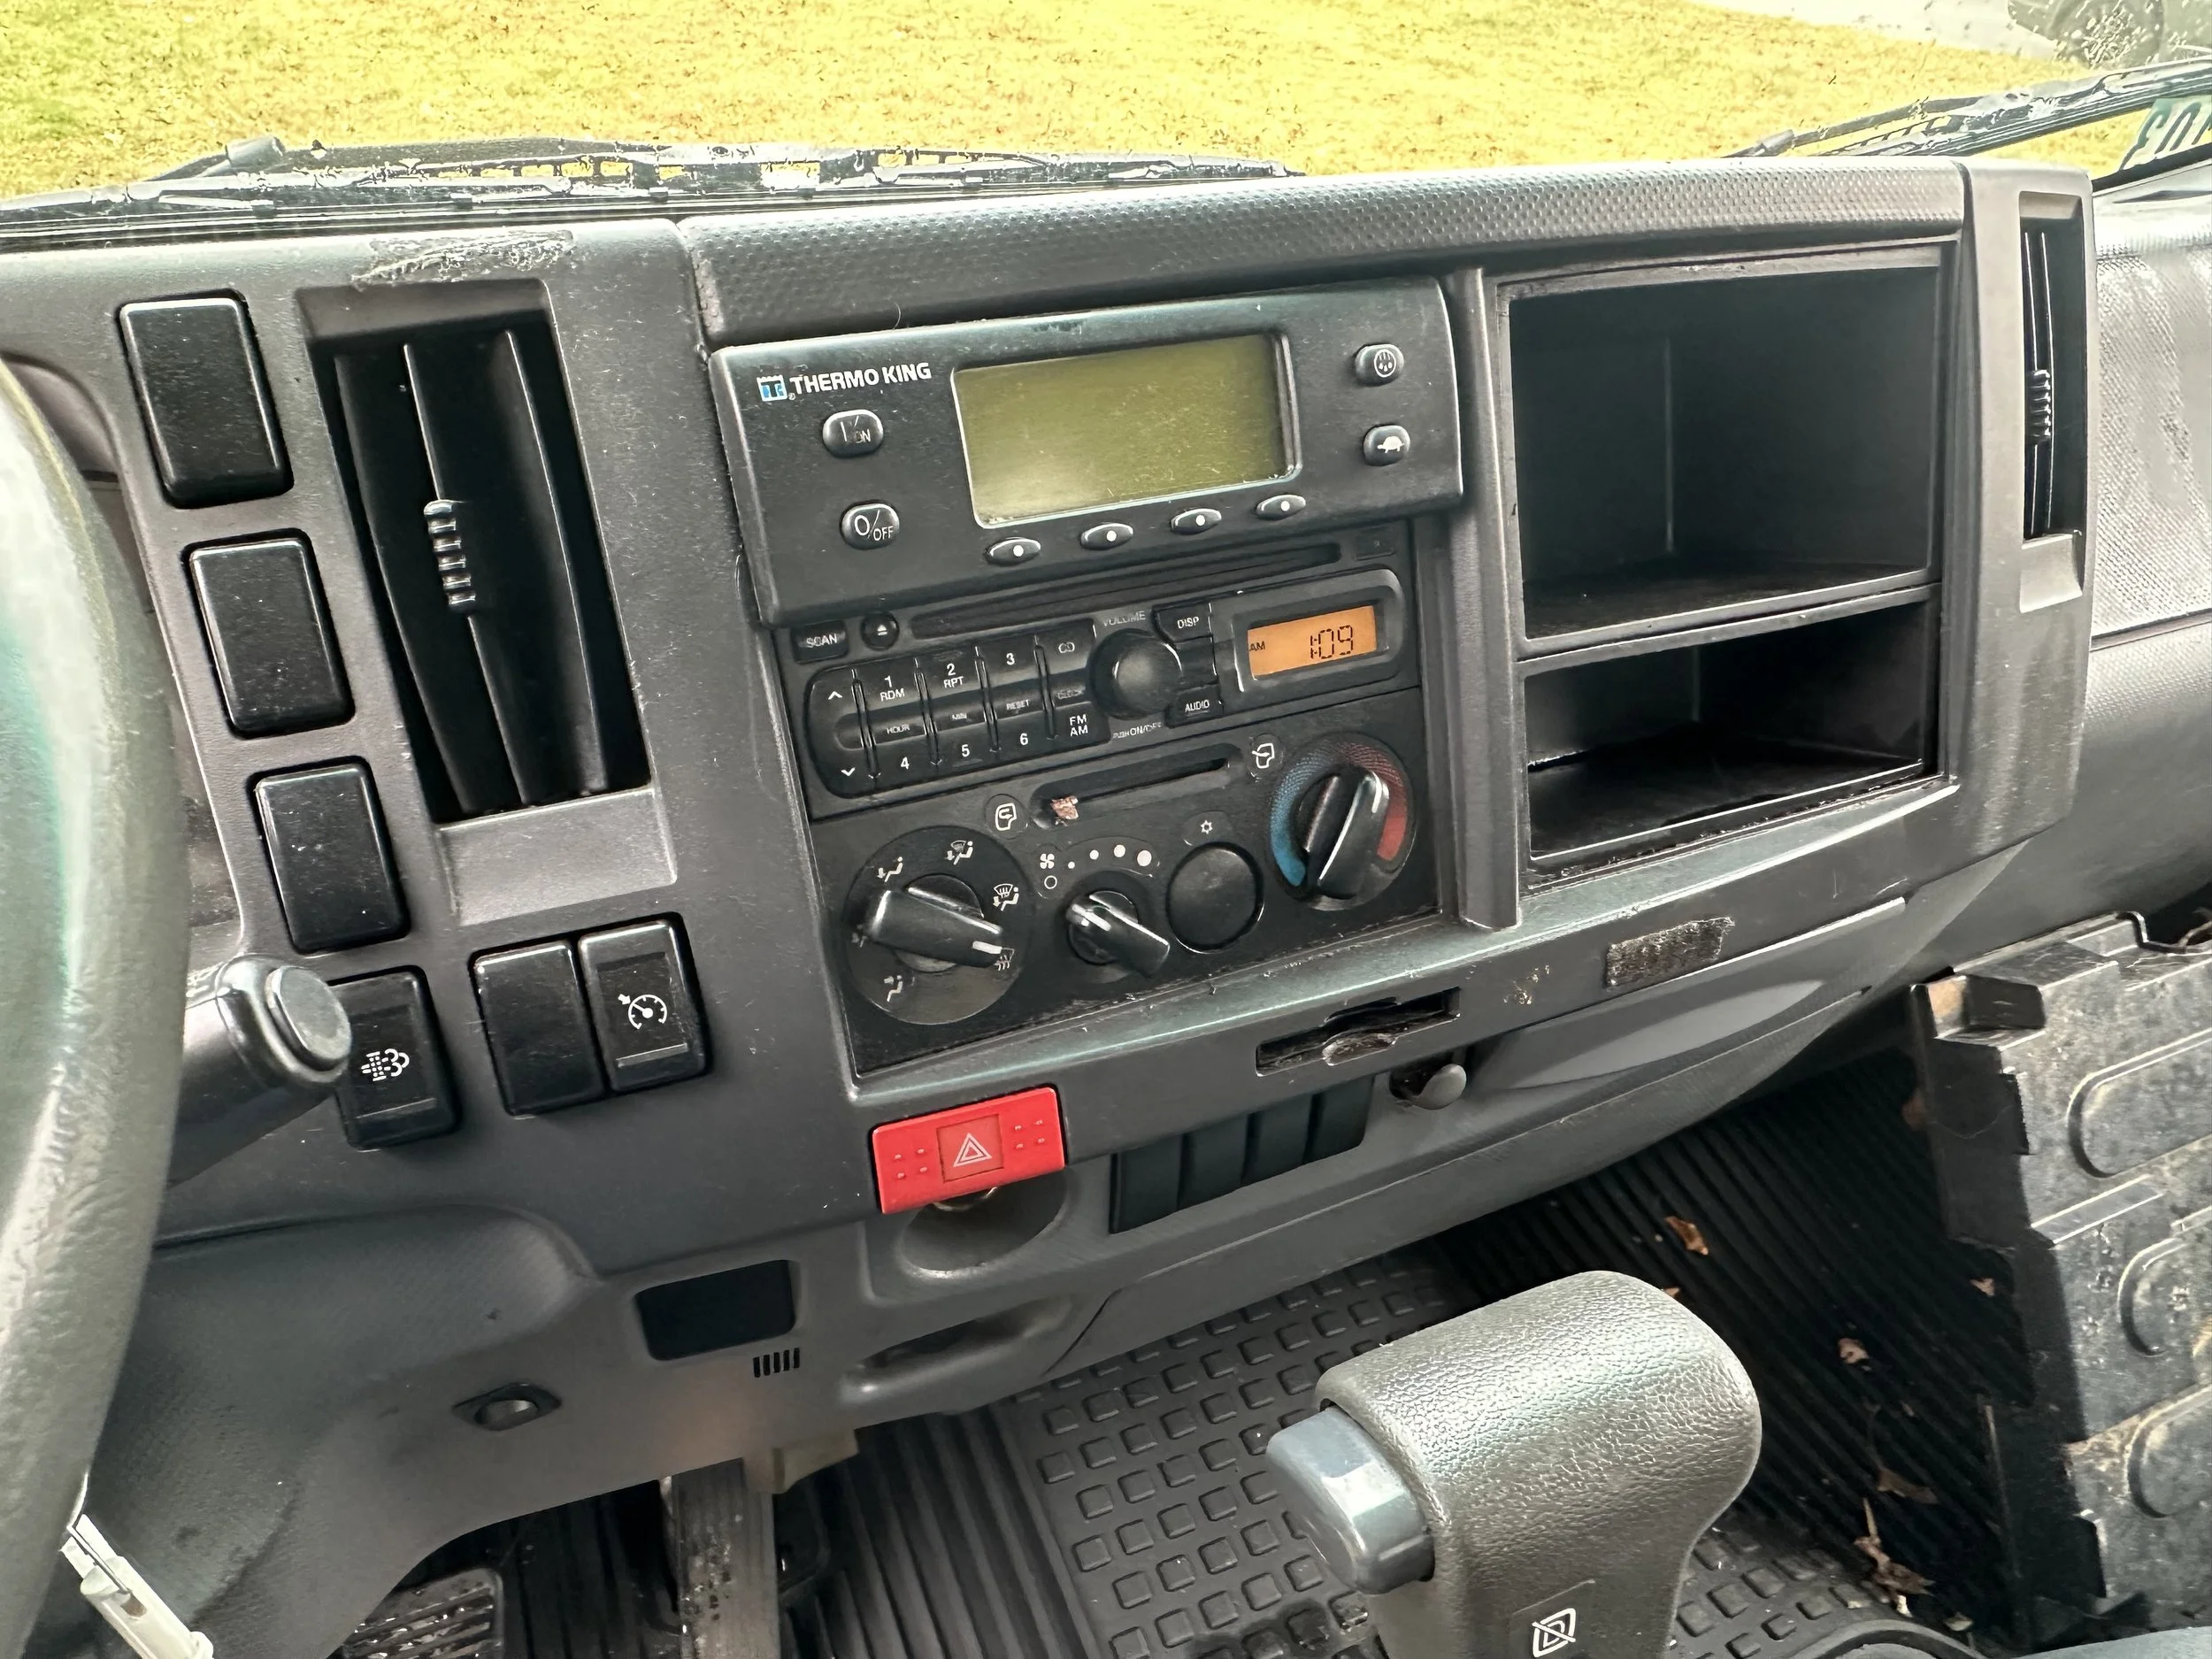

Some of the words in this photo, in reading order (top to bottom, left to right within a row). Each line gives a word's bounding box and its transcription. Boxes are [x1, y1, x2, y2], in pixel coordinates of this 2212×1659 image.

[789, 368, 879, 395] THERMO
[881, 362, 933, 384] KING
[1177, 616, 1200, 629] DISP
[806, 634, 838, 649] SCAN
[1249, 641, 1266, 652] AM
[1006, 652, 1015, 665] 3
[946, 663, 956, 676] 2
[885, 675, 893, 688] 1
[943, 676, 964, 688] RPT
[879, 687, 905, 702] RDM
[1184, 699, 1210, 713] AUDIO
[1069, 713, 1087, 726] FM
[886, 723, 910, 734] HOUR
[1070, 727, 1088, 737] AM
[1019, 733, 1029, 746] 6
[961, 744, 971, 758] 5
[900, 757, 910, 771] 4
